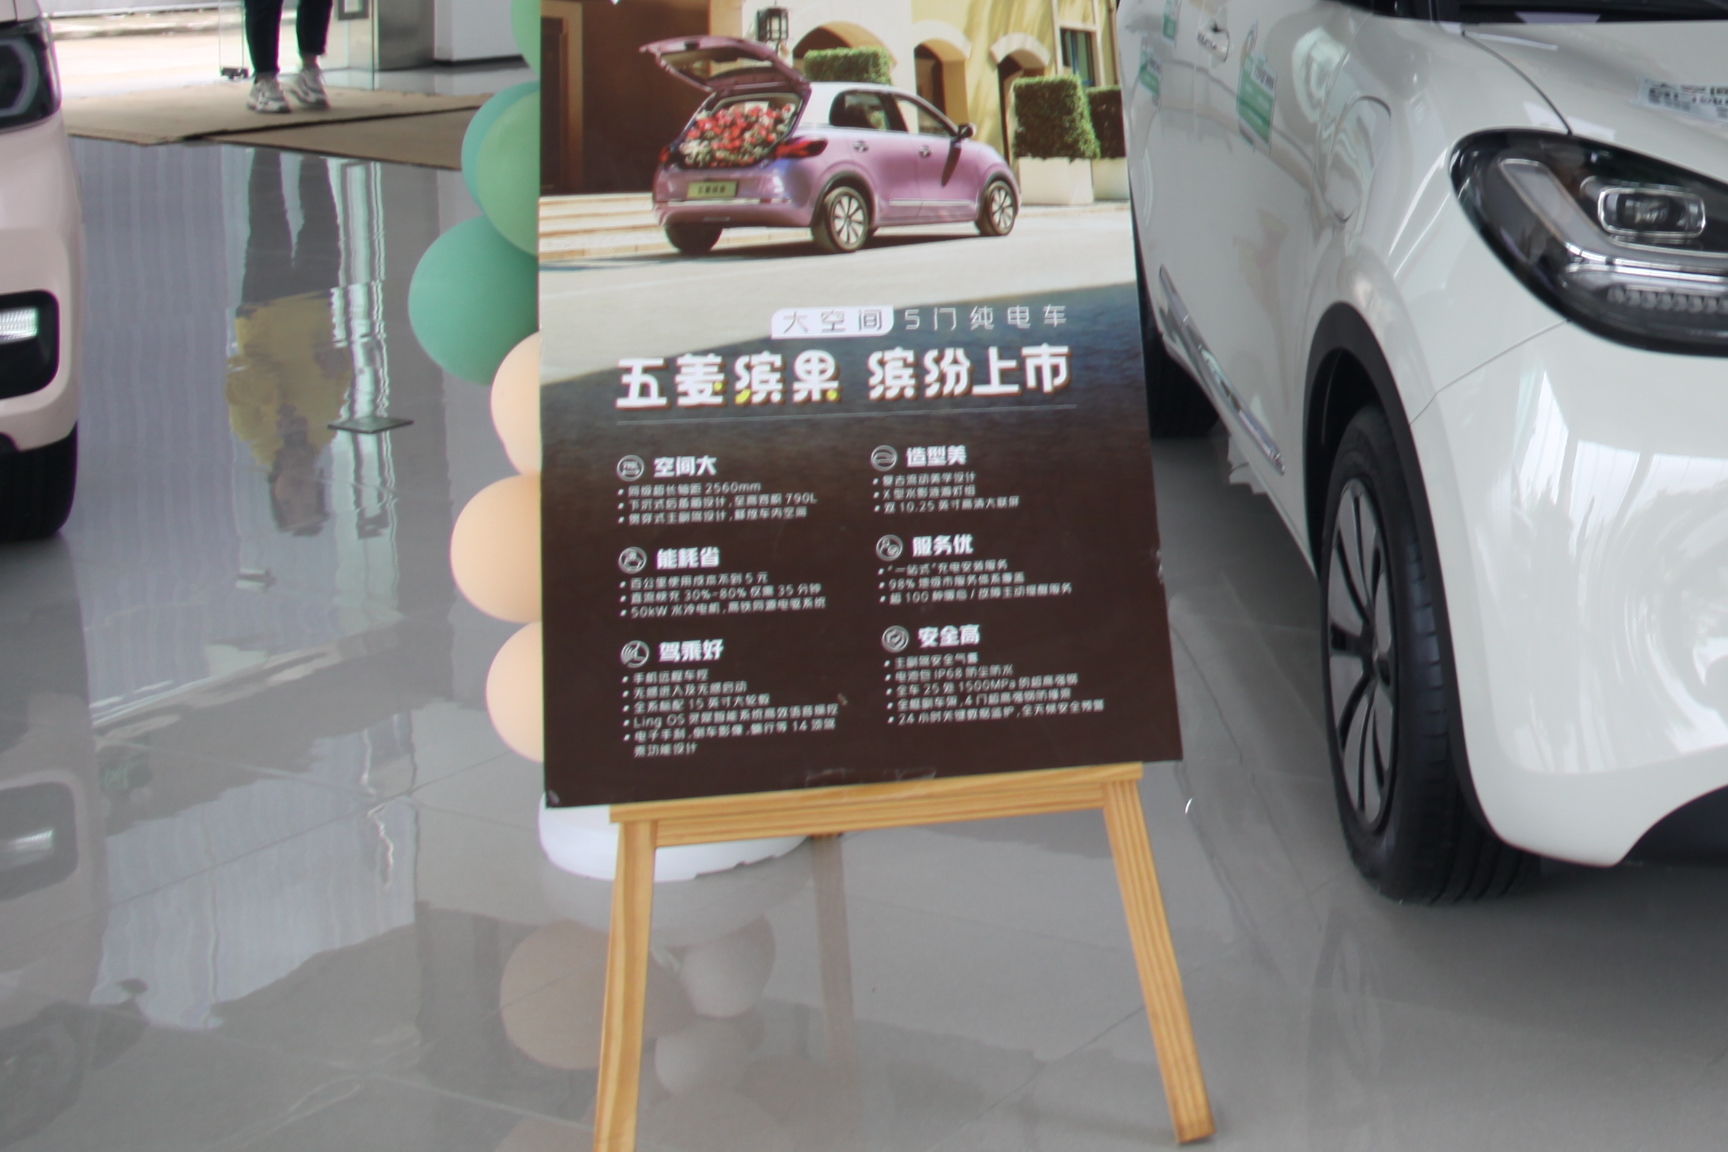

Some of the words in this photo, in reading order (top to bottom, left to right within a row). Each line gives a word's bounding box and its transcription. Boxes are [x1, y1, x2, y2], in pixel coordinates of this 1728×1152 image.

[783, 308, 883, 333] 大空间
[904, 303, 1067, 331] 5门纯电车
[616, 349, 841, 409] 五菱缤果
[868, 342, 1071, 401] 缤纷上市
[906, 445, 967, 468] 造型美
[653, 455, 717, 478] 空间大
[705, 481, 762, 494] 2560mm
[785, 492, 818, 505] 790L
[900, 499, 935, 513] 10.25
[912, 534, 974, 557] 服务优
[656, 546, 720, 570] 能耗省
[757, 571, 769, 584] 元
[777, 584, 793, 596] 35
[889, 578, 915, 592] 98%
[905, 590, 929, 603] 100
[631, 605, 668, 619] 50kW
[918, 624, 980, 649] 安全高
[658, 639, 724, 663] 驾乘好
[934, 666, 963, 680] IP68
[896, 683, 921, 697] 全车
[924, 681, 940, 694] 25
[959, 677, 1017, 693] 1500MPa
[689, 697, 704, 710] 15
[633, 715, 662, 729] Ling
[666, 712, 685, 726] OS
[792, 719, 808, 732] 14
[898, 713, 915, 726] 24
